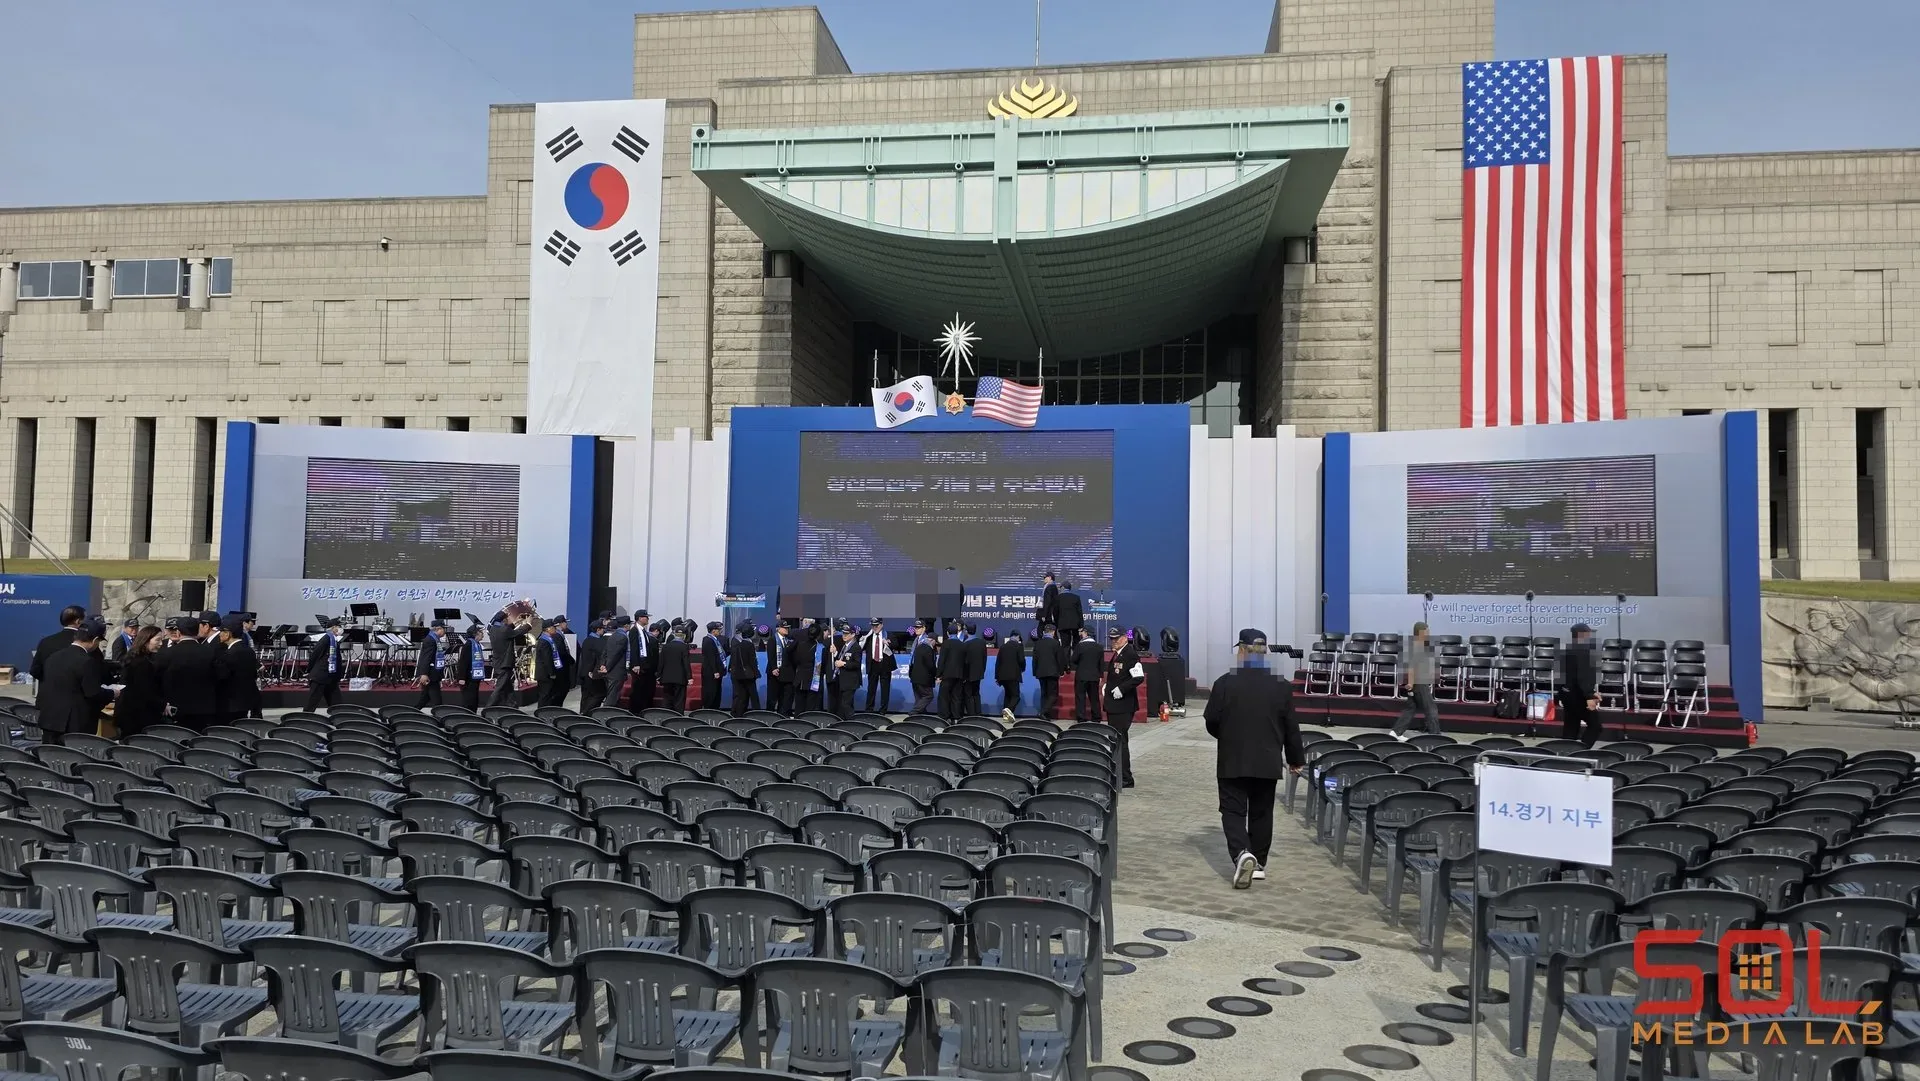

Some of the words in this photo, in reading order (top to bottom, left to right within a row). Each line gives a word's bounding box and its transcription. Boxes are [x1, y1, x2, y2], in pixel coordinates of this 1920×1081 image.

[301, 587, 360, 600] 장진호전투
[397, 588, 430, 601] 영원히
[985, 595, 997, 608] 및
[993, 611, 999, 619] of
[1001, 611, 1026, 620] Jangjin
[1093, 613, 1117, 621] Heroes
[1422, 603, 1439, 612] We
[1441, 603, 1458, 612] will
[1460, 604, 1488, 612] never
[1491, 603, 1522, 616] forget
[1524, 603, 1563, 613] forever
[1566, 604, 1583, 613] the
[1586, 604, 1623, 614] heroes
[1626, 604, 1638, 614] of
[1450, 613, 1467, 622] the
[1469, 614, 1505, 625] Jangjin
[1507, 614, 1553, 623] reservoir
[1488, 801, 1552, 824] 14.경기
[1562, 808, 1603, 829] 지부
